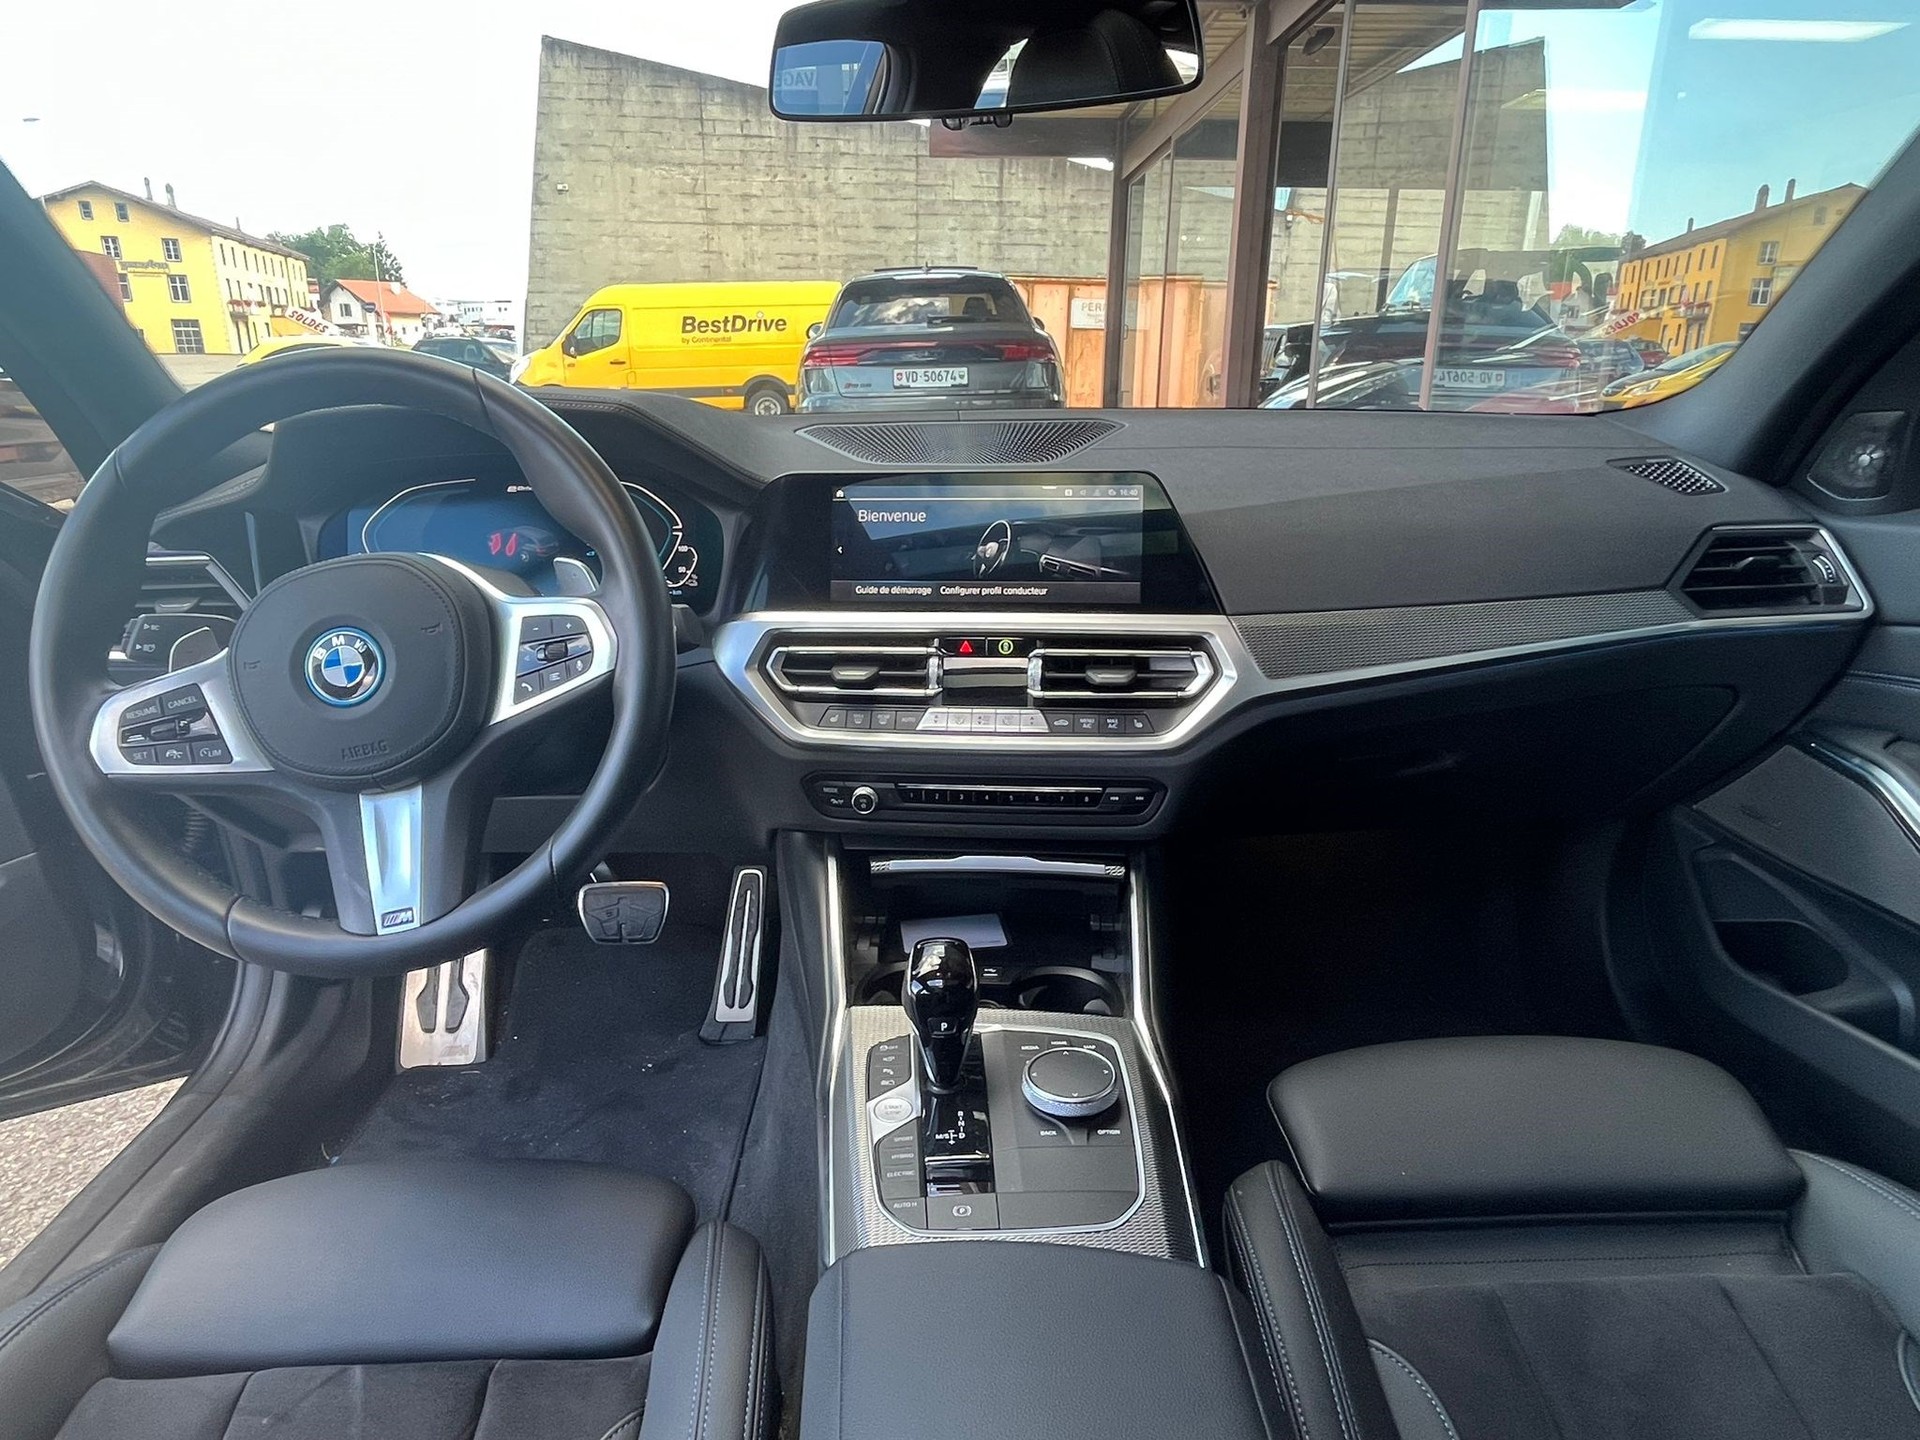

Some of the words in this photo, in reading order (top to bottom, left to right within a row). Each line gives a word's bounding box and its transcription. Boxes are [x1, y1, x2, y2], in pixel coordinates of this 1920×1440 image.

[1081, 302, 1106, 312] PER
[288, 310, 329, 333] SOLDES
[681, 311, 787, 334] BestDrive
[691, 336, 732, 344] Continental
[858, 509, 927, 522] Bienvenue
[855, 585, 876, 595] Guide
[880, 586, 890, 595] de
[890, 586, 932, 596] démarrage
[940, 586, 981, 596] Configurer
[981, 586, 1002, 596] profil
[1002, 587, 1048, 595] conducteur
[313, 634, 368, 661] BMW
[167, 696, 197, 709] CANCEL
[126, 705, 158, 719] RESUME
[133, 752, 148, 760] SET
[208, 749, 222, 758] LIM
[341, 740, 389, 760] AIRBAG
[940, 1022, 948, 1031] P
